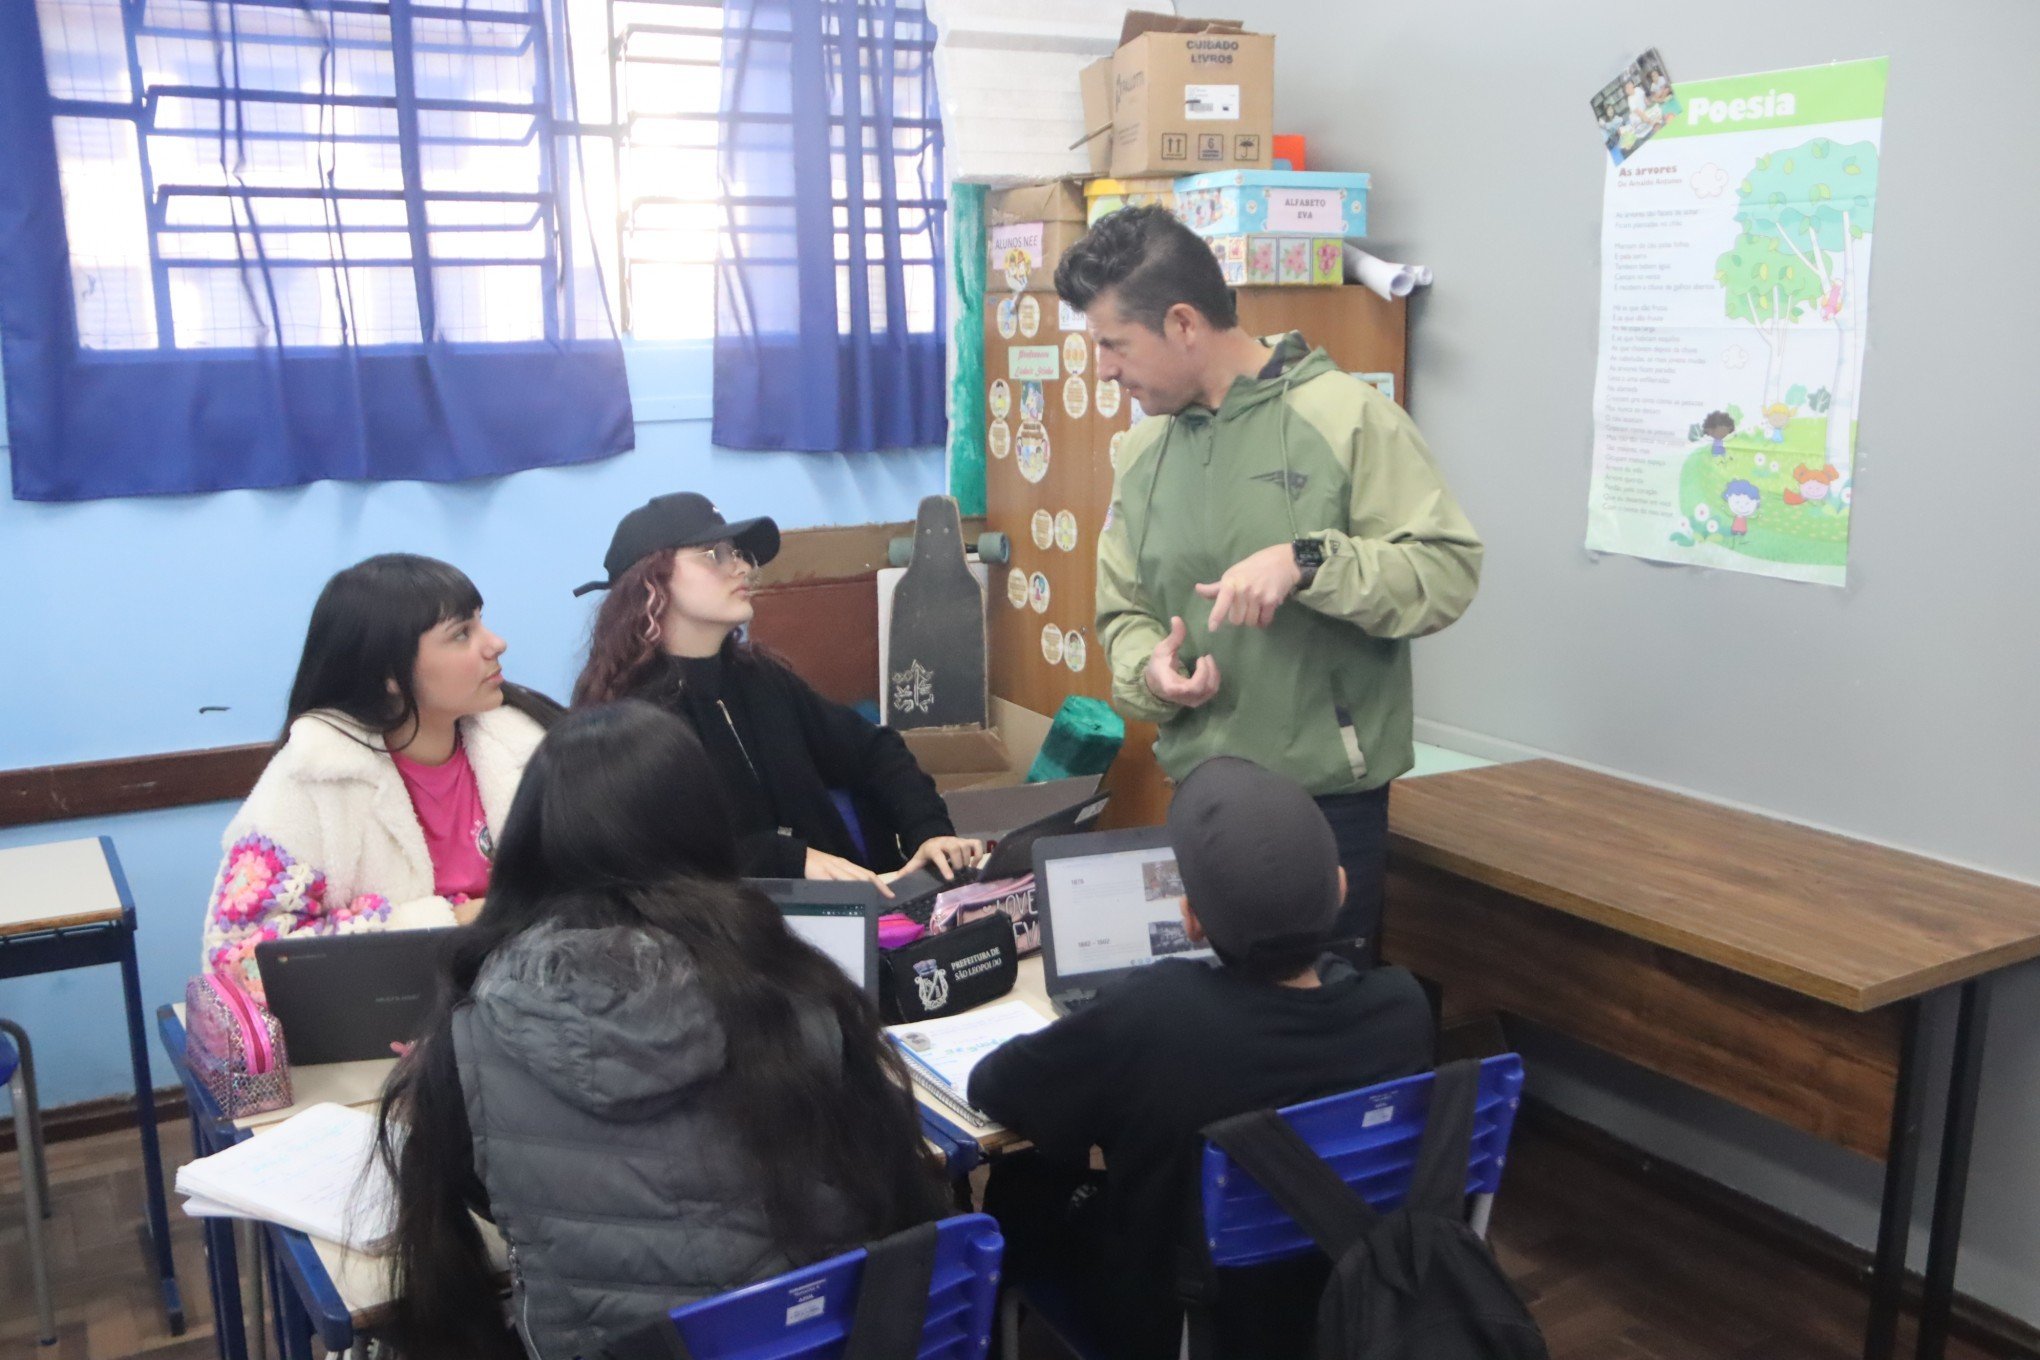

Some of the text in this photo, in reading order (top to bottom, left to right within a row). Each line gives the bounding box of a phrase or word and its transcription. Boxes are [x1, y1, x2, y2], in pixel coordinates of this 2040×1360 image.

[1191, 54, 1233, 64] LIVROS
[1687, 89, 1796, 125] Poesia
[1207, 137, 1215, 149] 6
[1285, 198, 1326, 208] ALFABETO
[1297, 210, 1313, 219] EVA
[995, 236, 1022, 250] ALUNOS
[951, 946, 1001, 970] PREFEITURA DE
[954, 957, 1002, 981] SÃO LEOPOLDO
